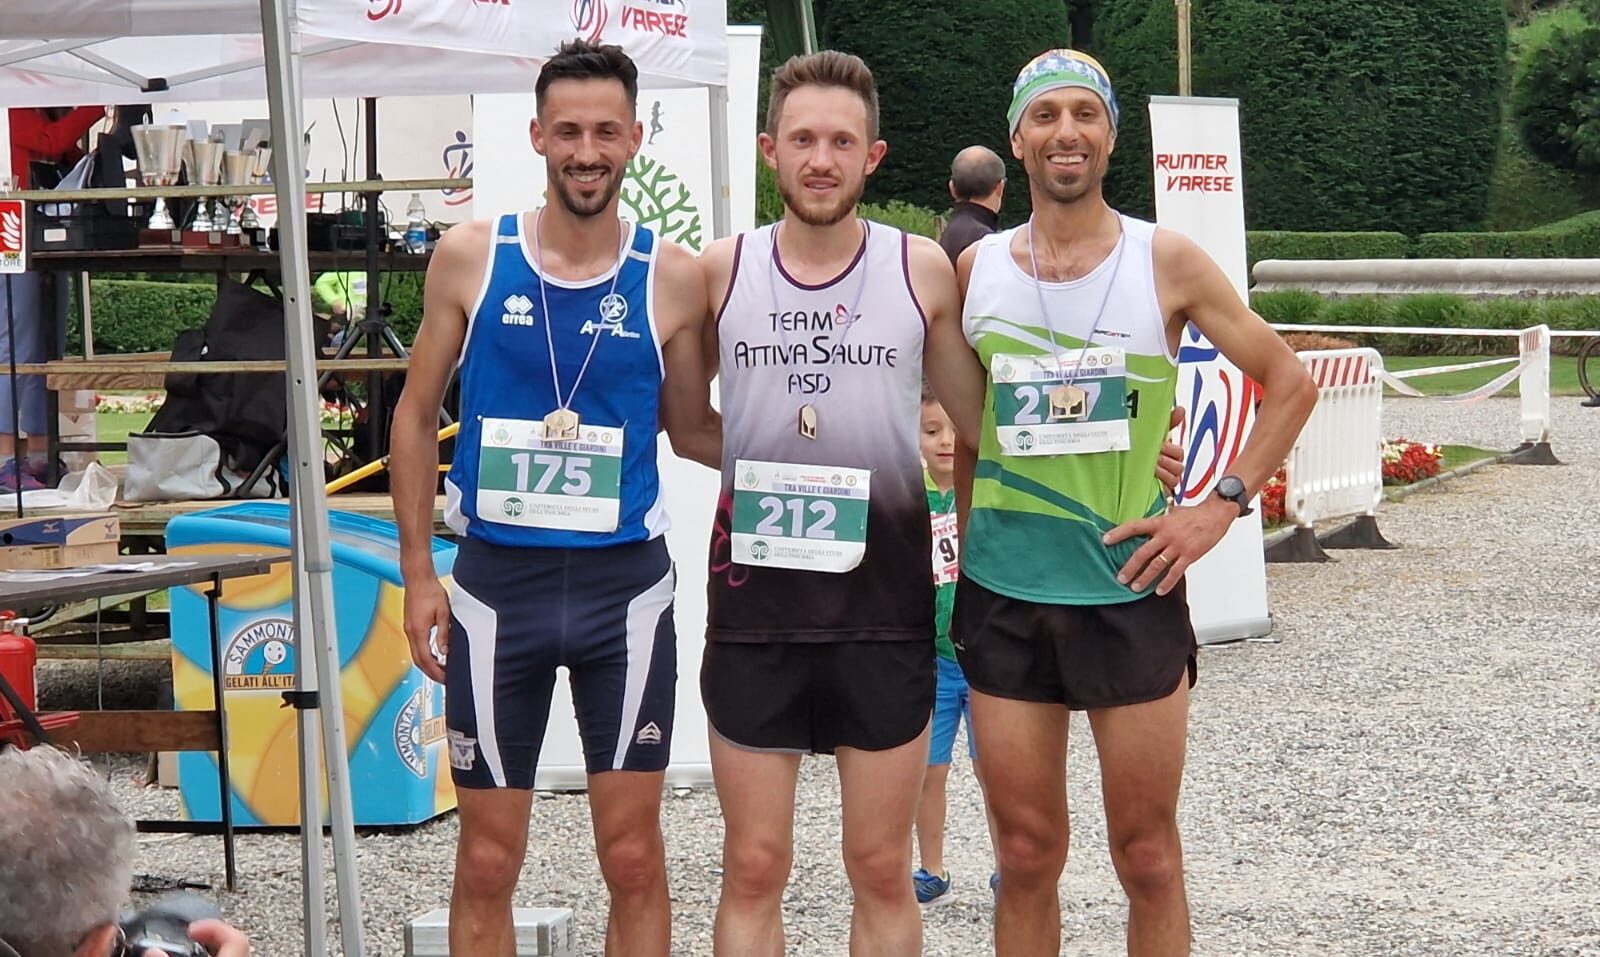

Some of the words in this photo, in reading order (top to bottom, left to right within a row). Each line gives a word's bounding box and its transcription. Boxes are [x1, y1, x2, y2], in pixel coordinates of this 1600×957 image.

[620, 6, 688, 39] VARESE
[1156, 153, 1228, 174] RUNNER
[1166, 175, 1234, 195] VARESE
[769, 311, 833, 332] TEAM
[788, 373, 831, 394] ASD
[511, 452, 592, 496] 175
[756, 496, 837, 540] 212
[229, 623, 296, 665] SAMMONT
[226, 677, 259, 688] GELATI
